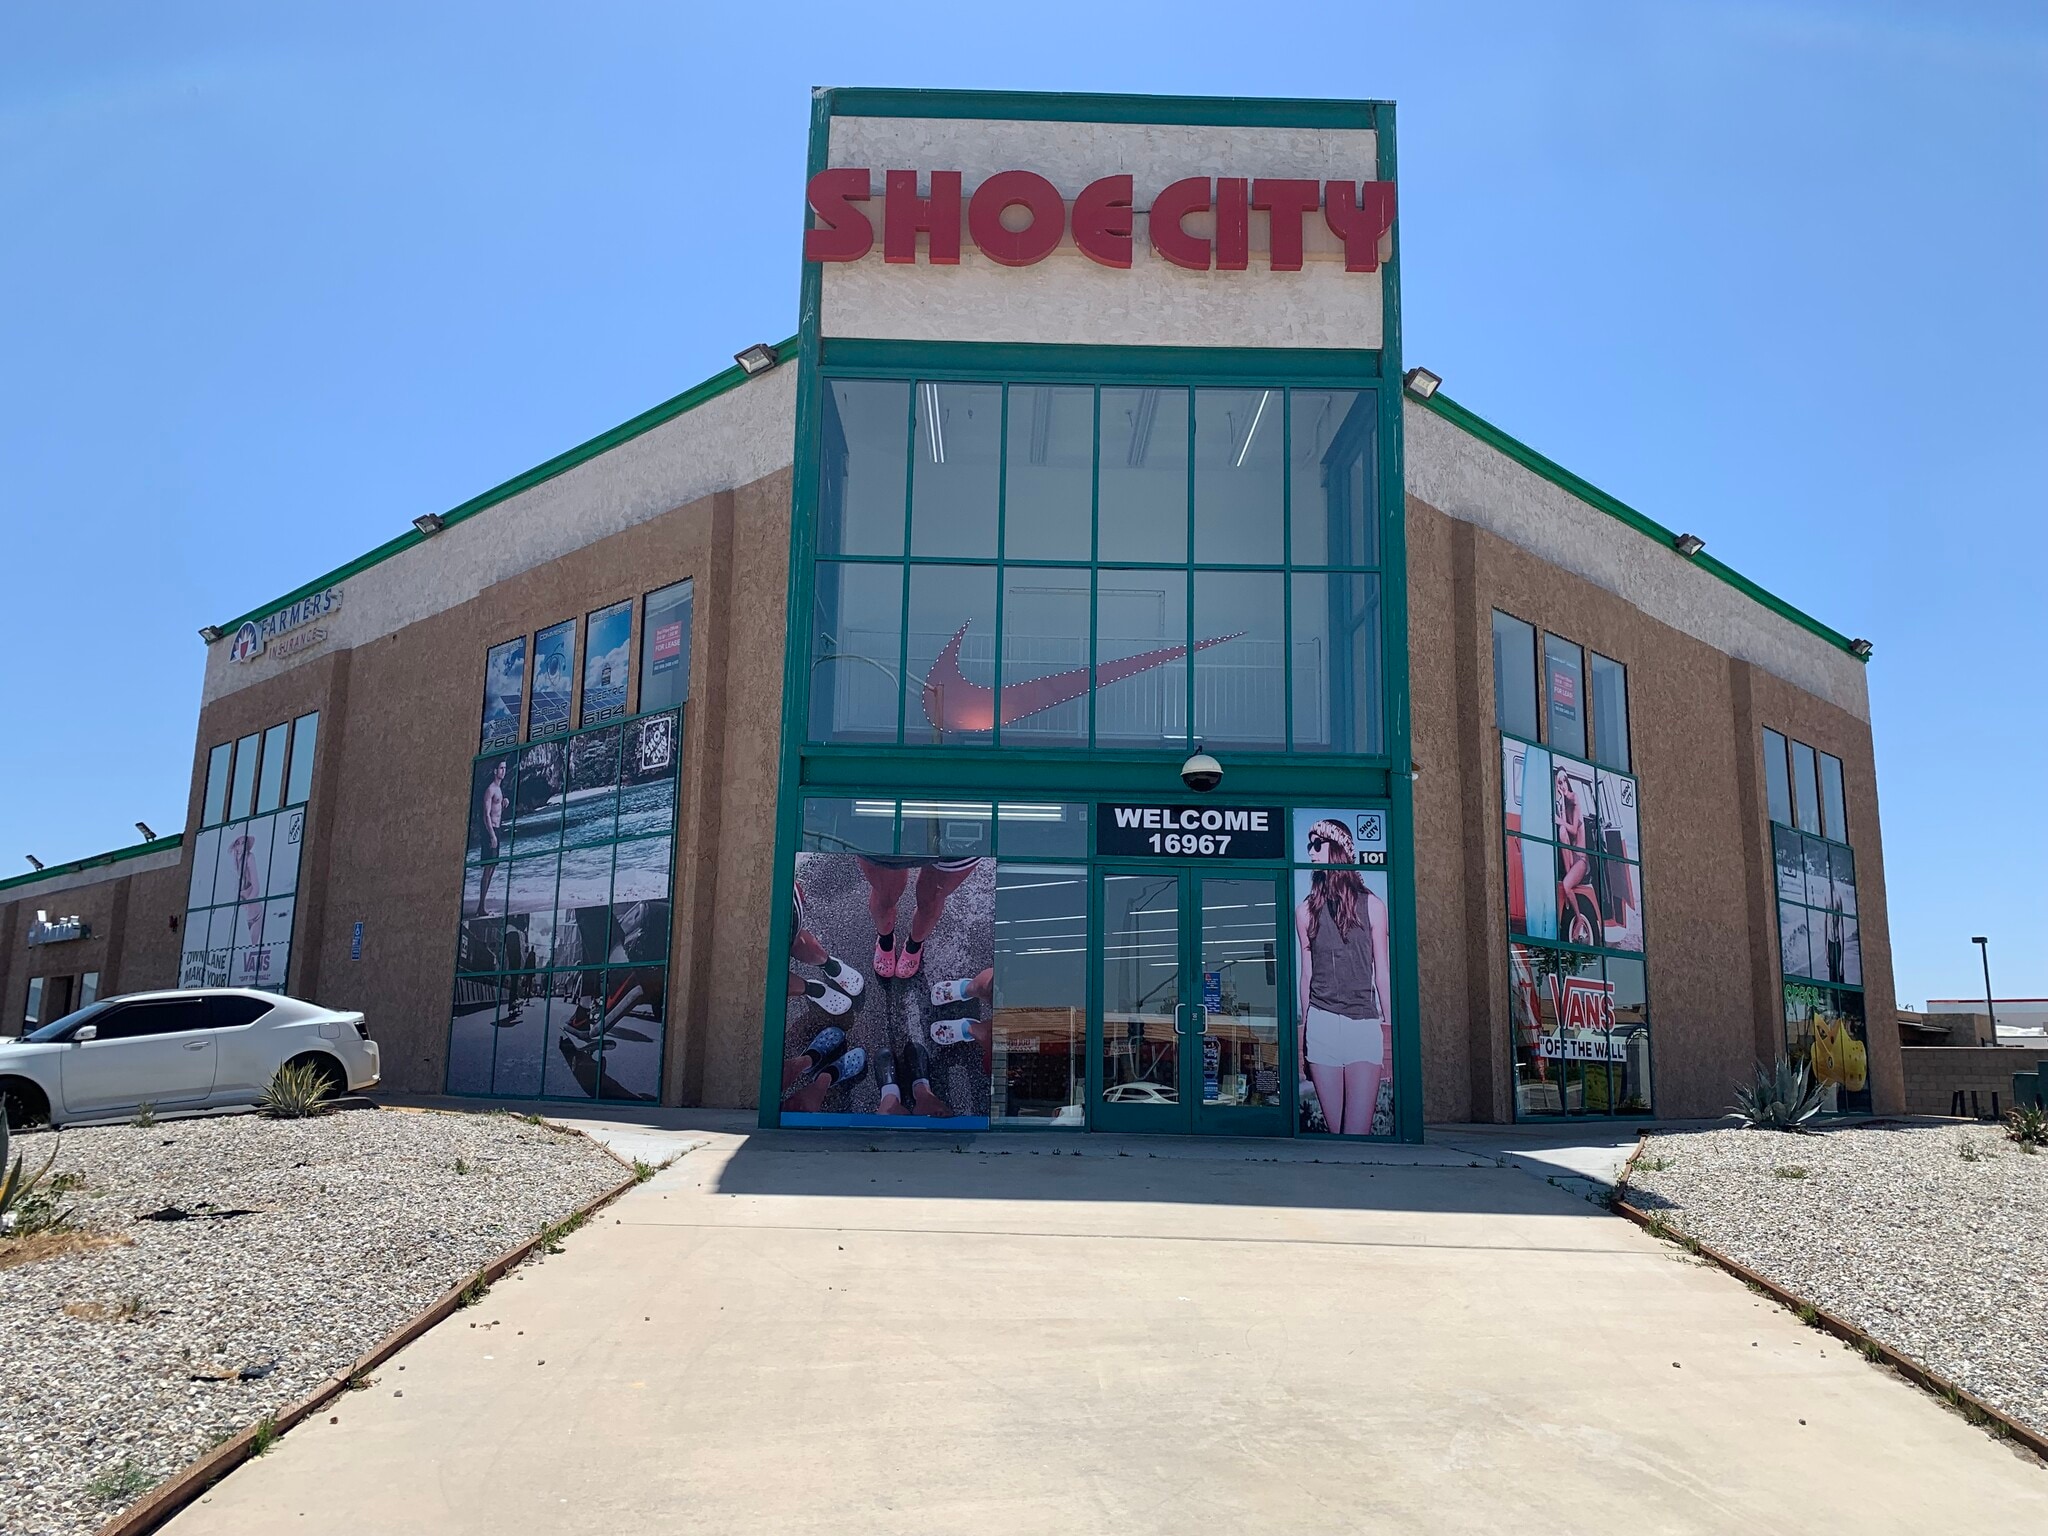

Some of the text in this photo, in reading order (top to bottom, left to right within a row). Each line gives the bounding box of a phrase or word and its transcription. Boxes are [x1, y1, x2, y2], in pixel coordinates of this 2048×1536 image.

[804, 168, 1395, 272] SHOE CITY
[260, 588, 332, 640] FARMERS
[483, 704, 626, 751] 760 206 6184
[645, 722, 666, 758] SHOE
[653, 735, 668, 763] CITY
[1114, 807, 1269, 832] WELCOME
[1359, 816, 1376, 834] SHOE
[1366, 824, 1379, 838] CITY
[1148, 833, 1232, 855] 16967
[1362, 852, 1384, 864] 101
[207, 951, 227, 970] LANE
[243, 949, 271, 972] VANS
[184, 966, 203, 984] MAK
[1549, 973, 1615, 1033] VANS
[1570, 1040, 1592, 1057] THE
